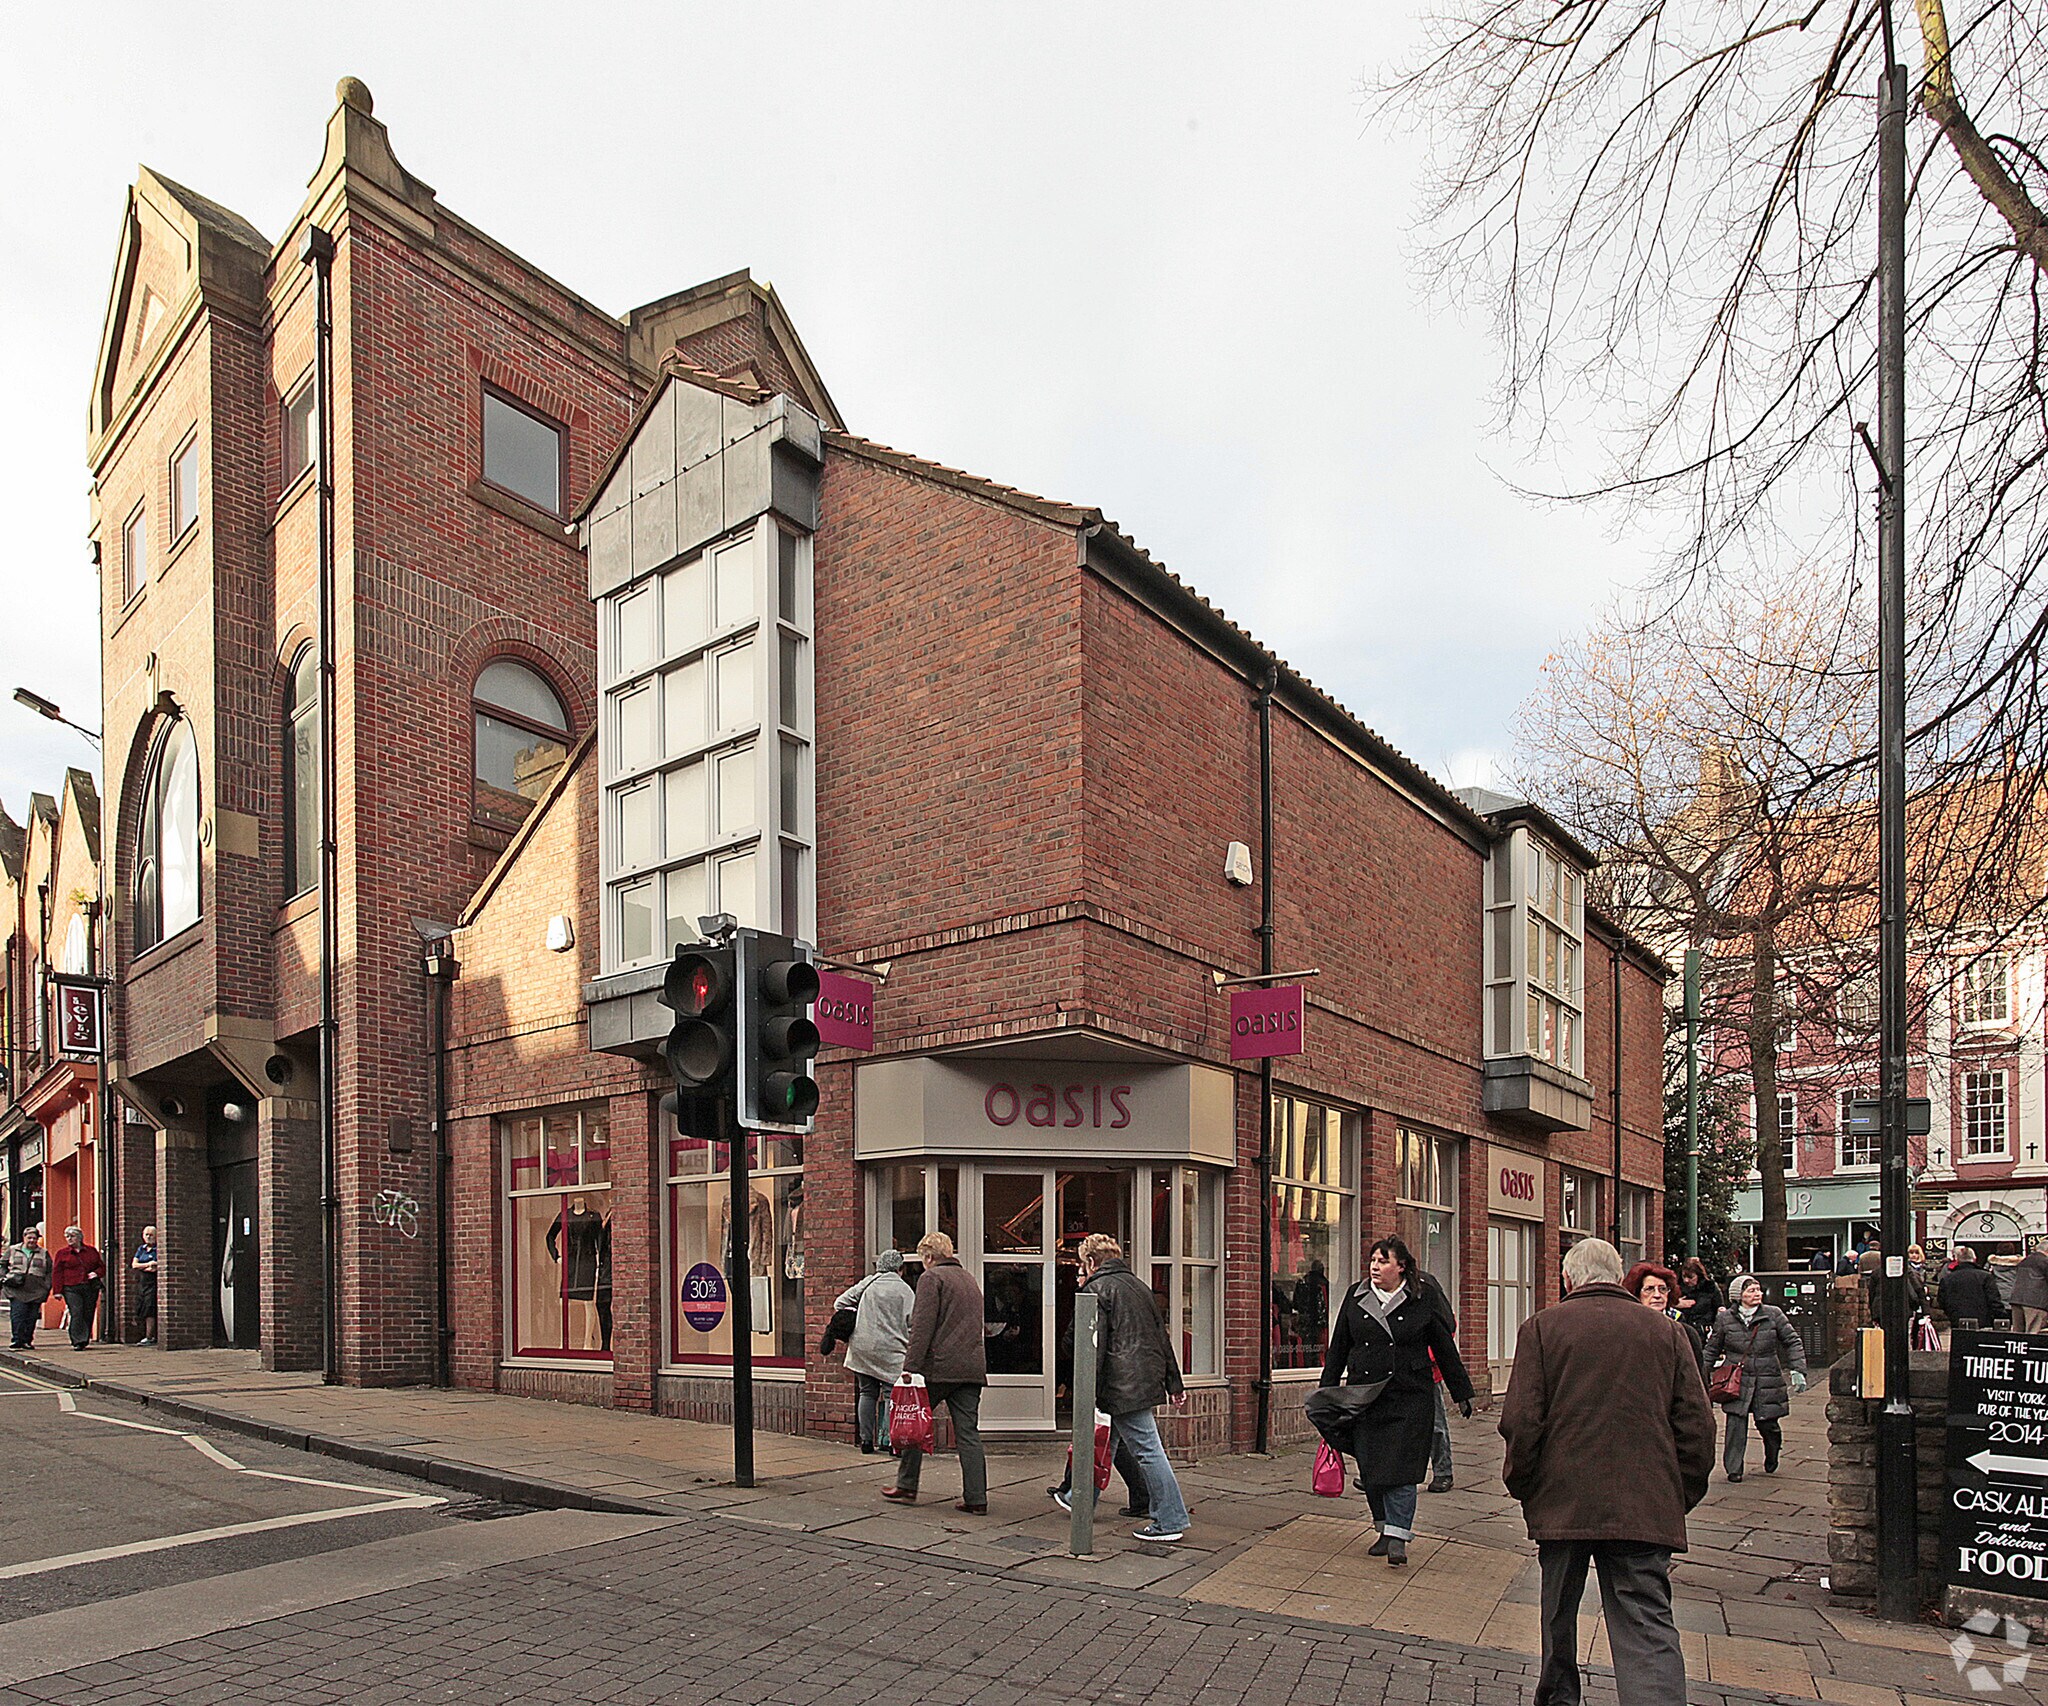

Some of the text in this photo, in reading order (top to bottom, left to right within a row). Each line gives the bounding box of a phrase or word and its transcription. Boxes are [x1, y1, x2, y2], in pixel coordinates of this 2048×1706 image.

[818, 996, 870, 1026] oasis
[1235, 1009, 1297, 1036] oasis
[984, 1082, 1131, 1128] oasis
[1500, 1167, 1535, 1201] oasis
[1979, 1213, 1996, 1234] 8
[690, 1280, 717, 1299] 30%
[2004, 1340, 2028, 1355] THE
[1962, 1355, 2048, 1384] THREE TU
[1977, 1403, 1997, 1416] PUB
[1998, 1405, 2012, 1418] OF
[2014, 1406, 2032, 1420] THE
[1988, 1421, 2045, 1445] 2014
[1953, 1488, 2013, 1514] CASK
[1998, 1522, 2031, 1533] and
[1974, 1531, 2047, 1551] Delicious
[1958, 1546, 2048, 1582] FOOD
